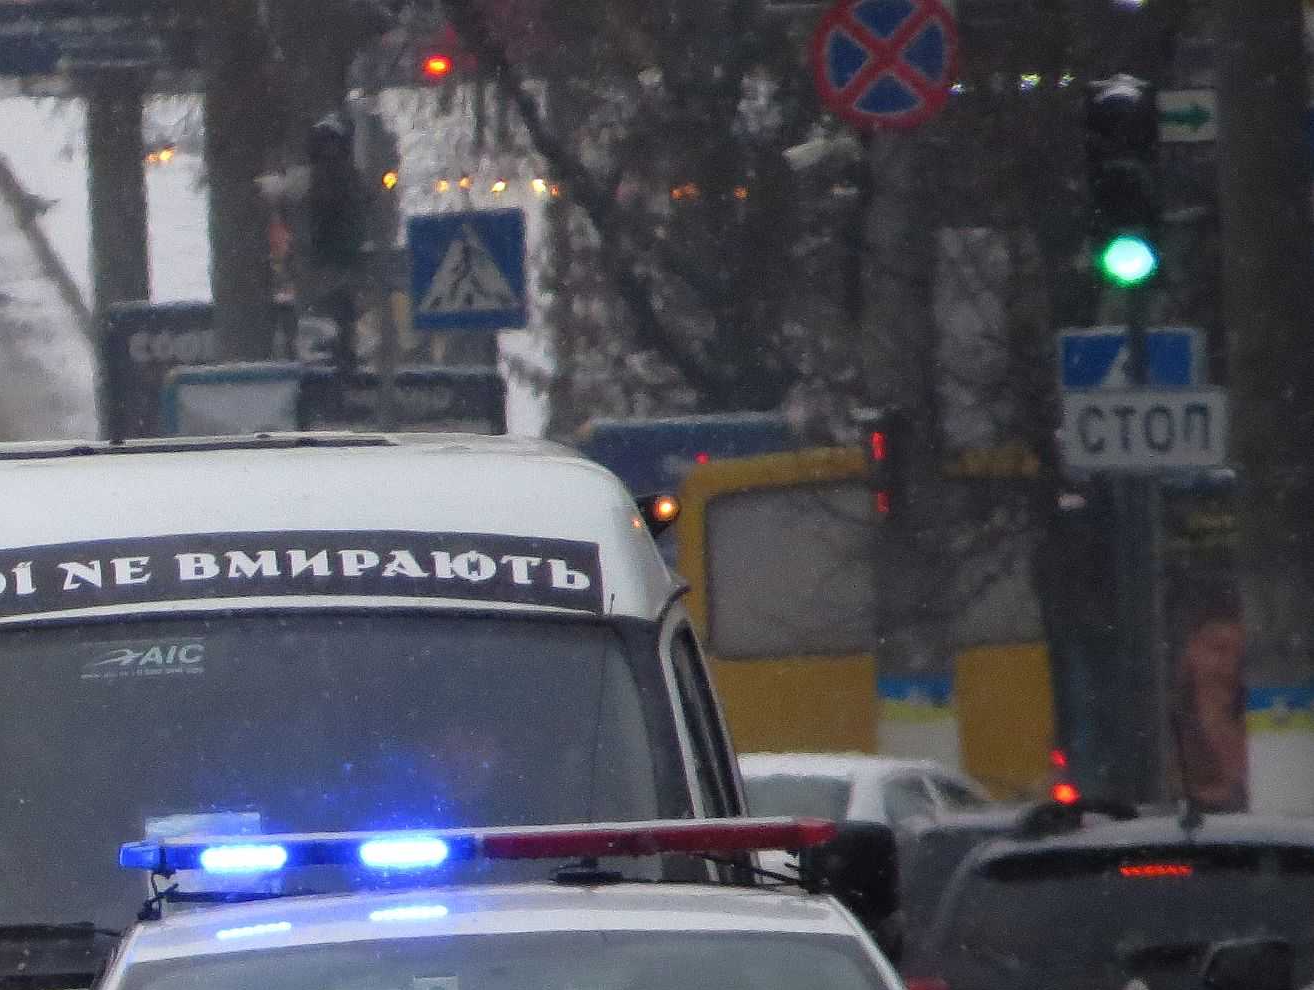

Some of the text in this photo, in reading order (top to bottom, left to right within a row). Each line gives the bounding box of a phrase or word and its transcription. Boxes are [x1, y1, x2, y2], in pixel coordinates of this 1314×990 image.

[1077, 404, 1211, 453] СТОП
[173, 550, 592, 589] ВМИРАЮТЬ
[139, 643, 206, 666] AIC
